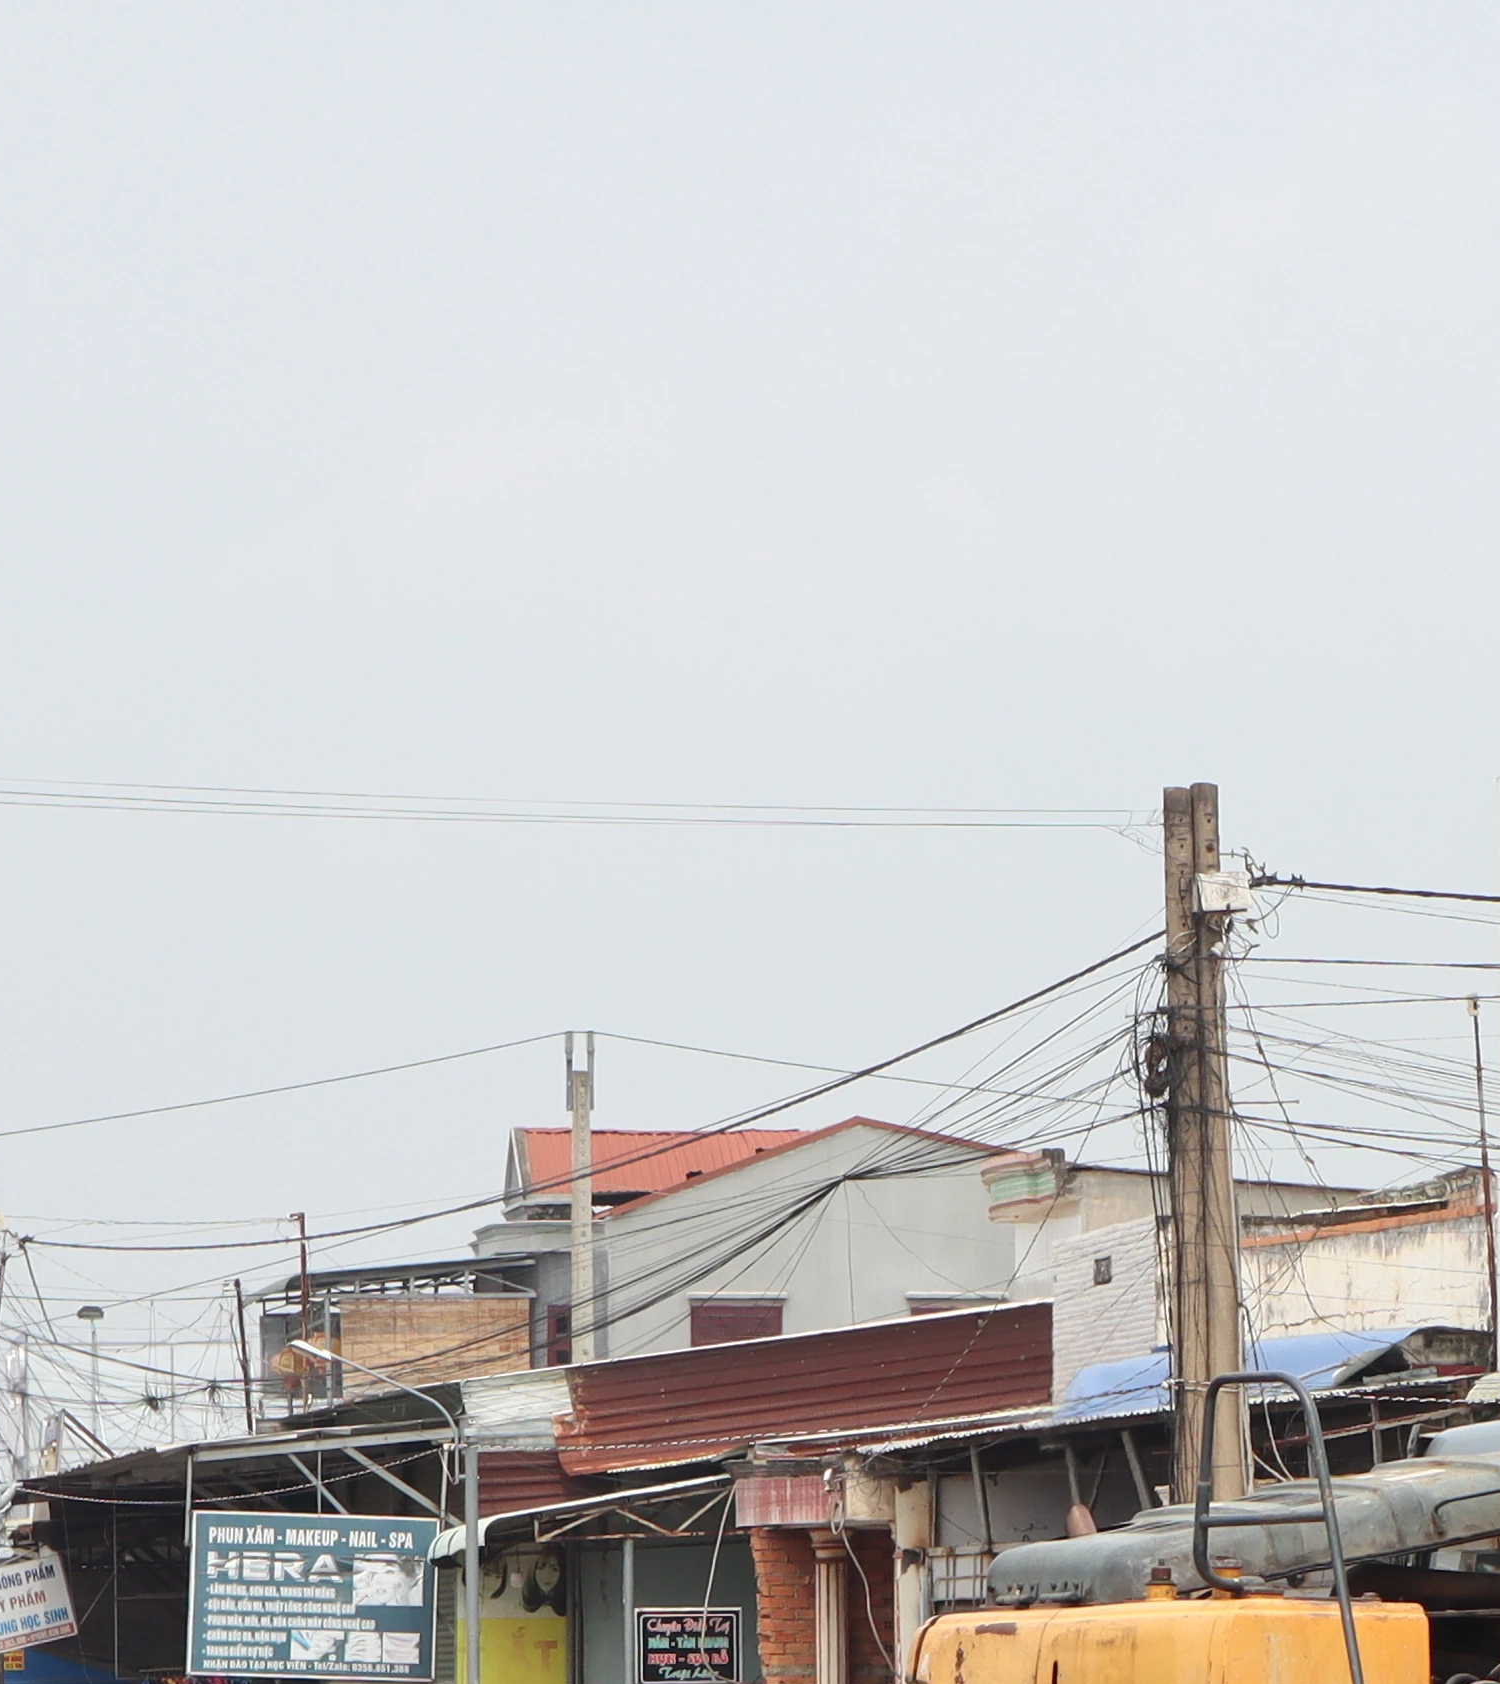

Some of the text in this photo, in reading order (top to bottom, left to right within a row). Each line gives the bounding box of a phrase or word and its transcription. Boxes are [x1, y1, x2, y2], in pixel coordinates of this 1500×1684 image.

[208, 1524, 413, 1549] PHUN XĂM MAKEUP NAIL SPA
[24, 1561, 56, 1586] PHẨM
[207, 1551, 343, 1584] HERA
[20, 1613, 41, 1631] HỌC
[43, 1607, 69, 1625] SINH
